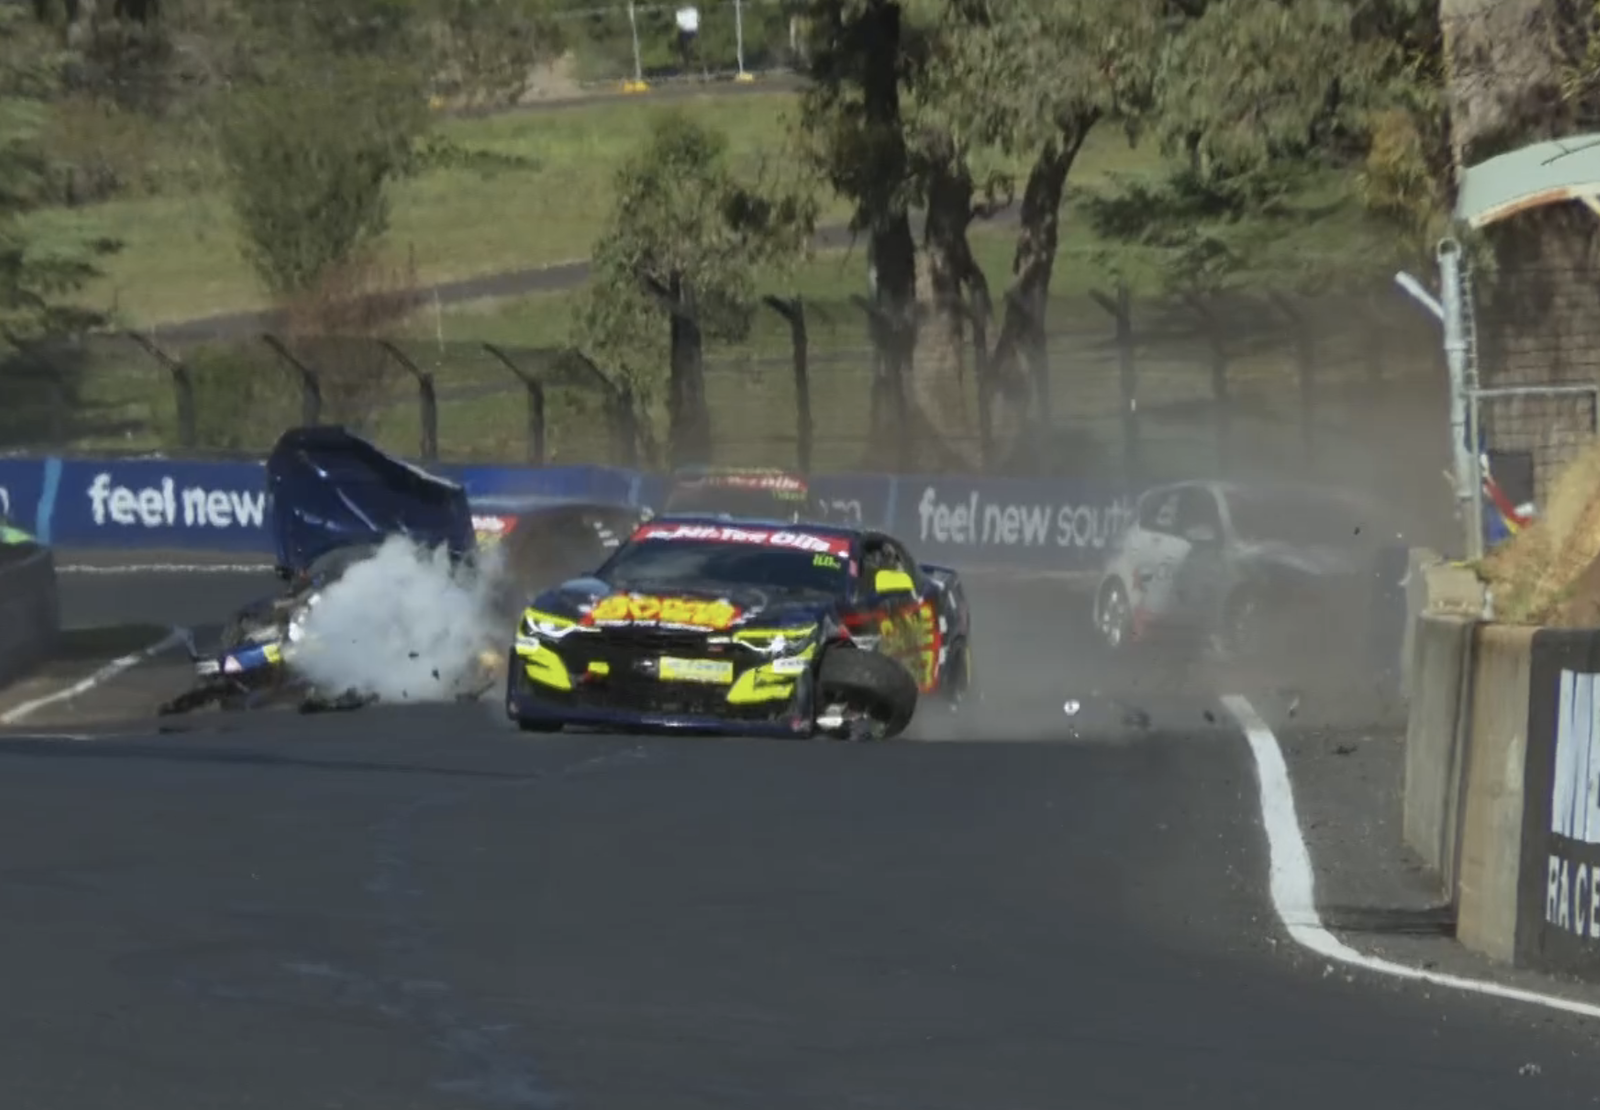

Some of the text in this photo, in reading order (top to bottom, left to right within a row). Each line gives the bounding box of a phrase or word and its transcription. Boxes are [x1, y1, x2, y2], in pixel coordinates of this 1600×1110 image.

[88, 472, 265, 527] feel new
[918, 486, 979, 543] feel
[982, 504, 1051, 545] new
